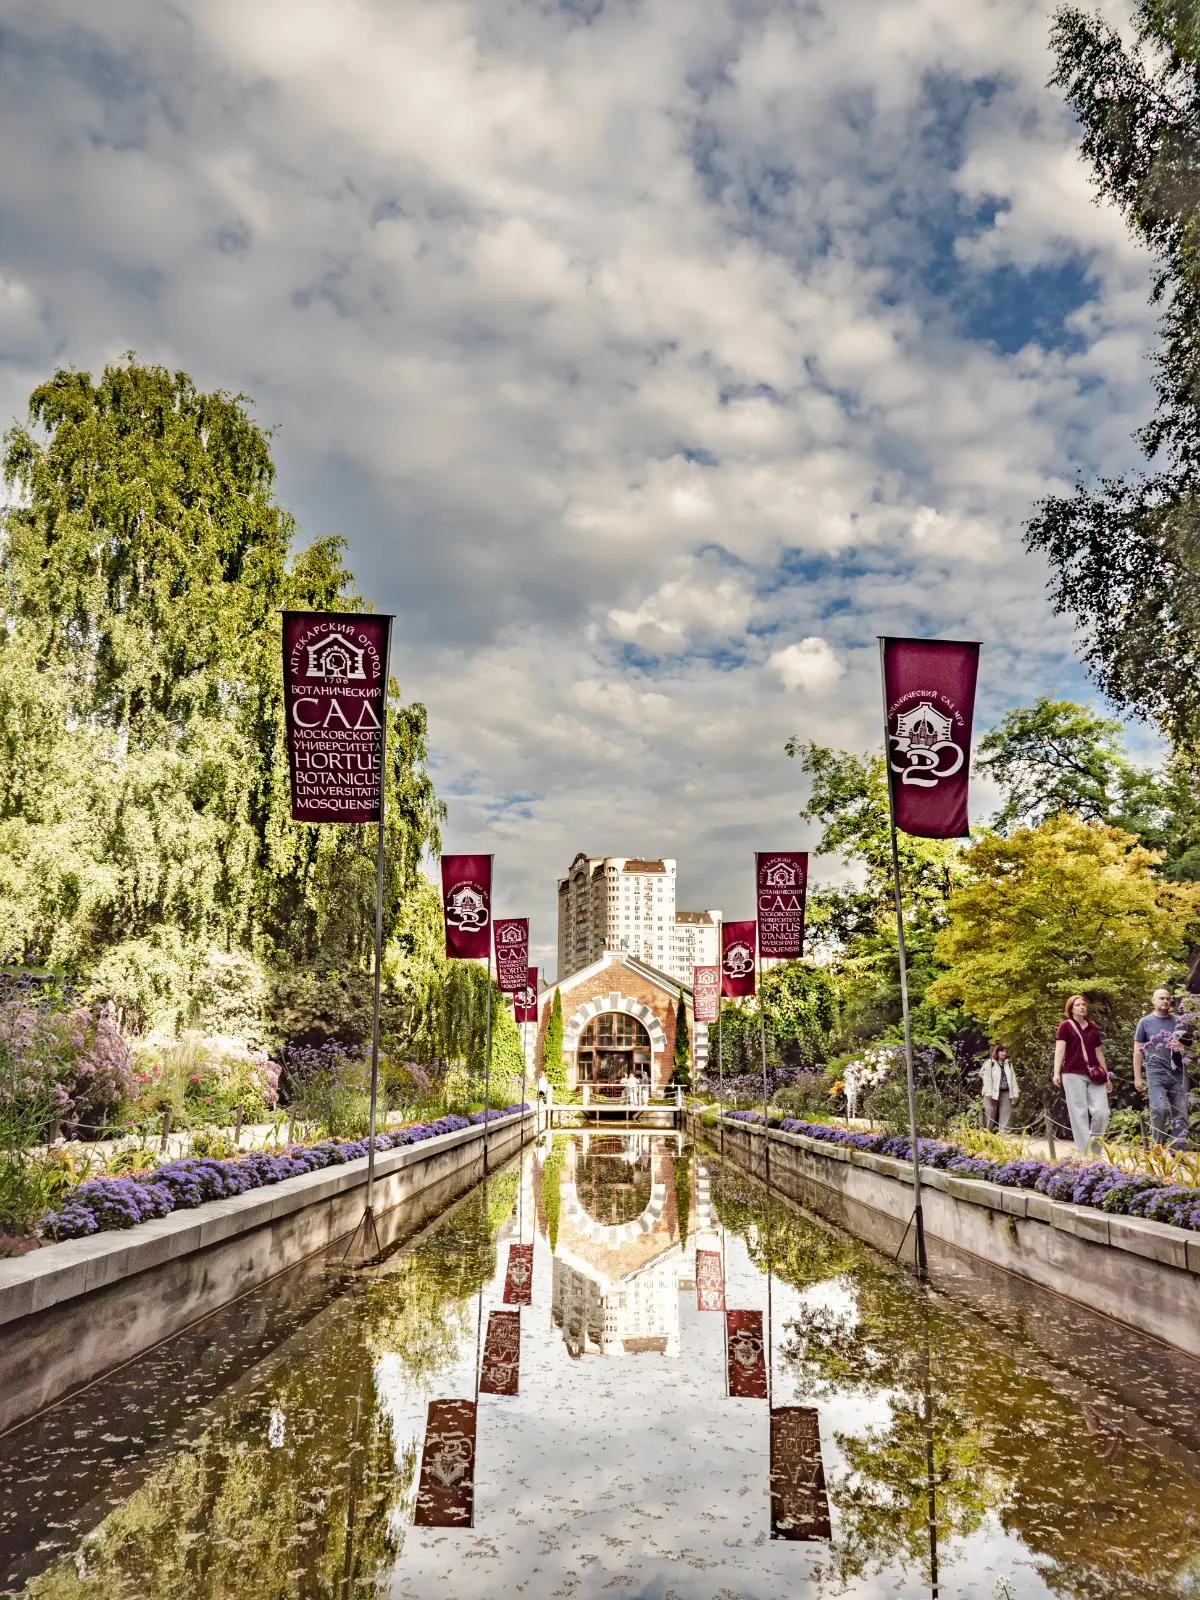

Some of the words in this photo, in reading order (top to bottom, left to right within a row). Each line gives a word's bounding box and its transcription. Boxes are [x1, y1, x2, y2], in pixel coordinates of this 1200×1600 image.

[290, 622, 355, 675] АПТЕКАРСКИЙ
[358, 634, 381, 679] ОГОРОД
[324, 677, 349, 685] 1706
[291, 685, 381, 698] БОТАНИЧЕСКИЙ
[292, 697, 382, 731] САД
[293, 729, 382, 741] МОСКОВСКОГО
[293, 740, 382, 752] УНИВЕРСИТЕТА
[295, 752, 381, 770] HORTUS
[296, 771, 381, 785] BOTANICUS
[296, 786, 380, 797] UNIVERSITATIS
[296, 798, 380, 811] MOSQUENSIS
[759, 895, 802, 911] САД
[761, 932, 800, 940] OTANICUS
[498, 947, 528, 961] САД
[499, 967, 527, 975] HORTU
